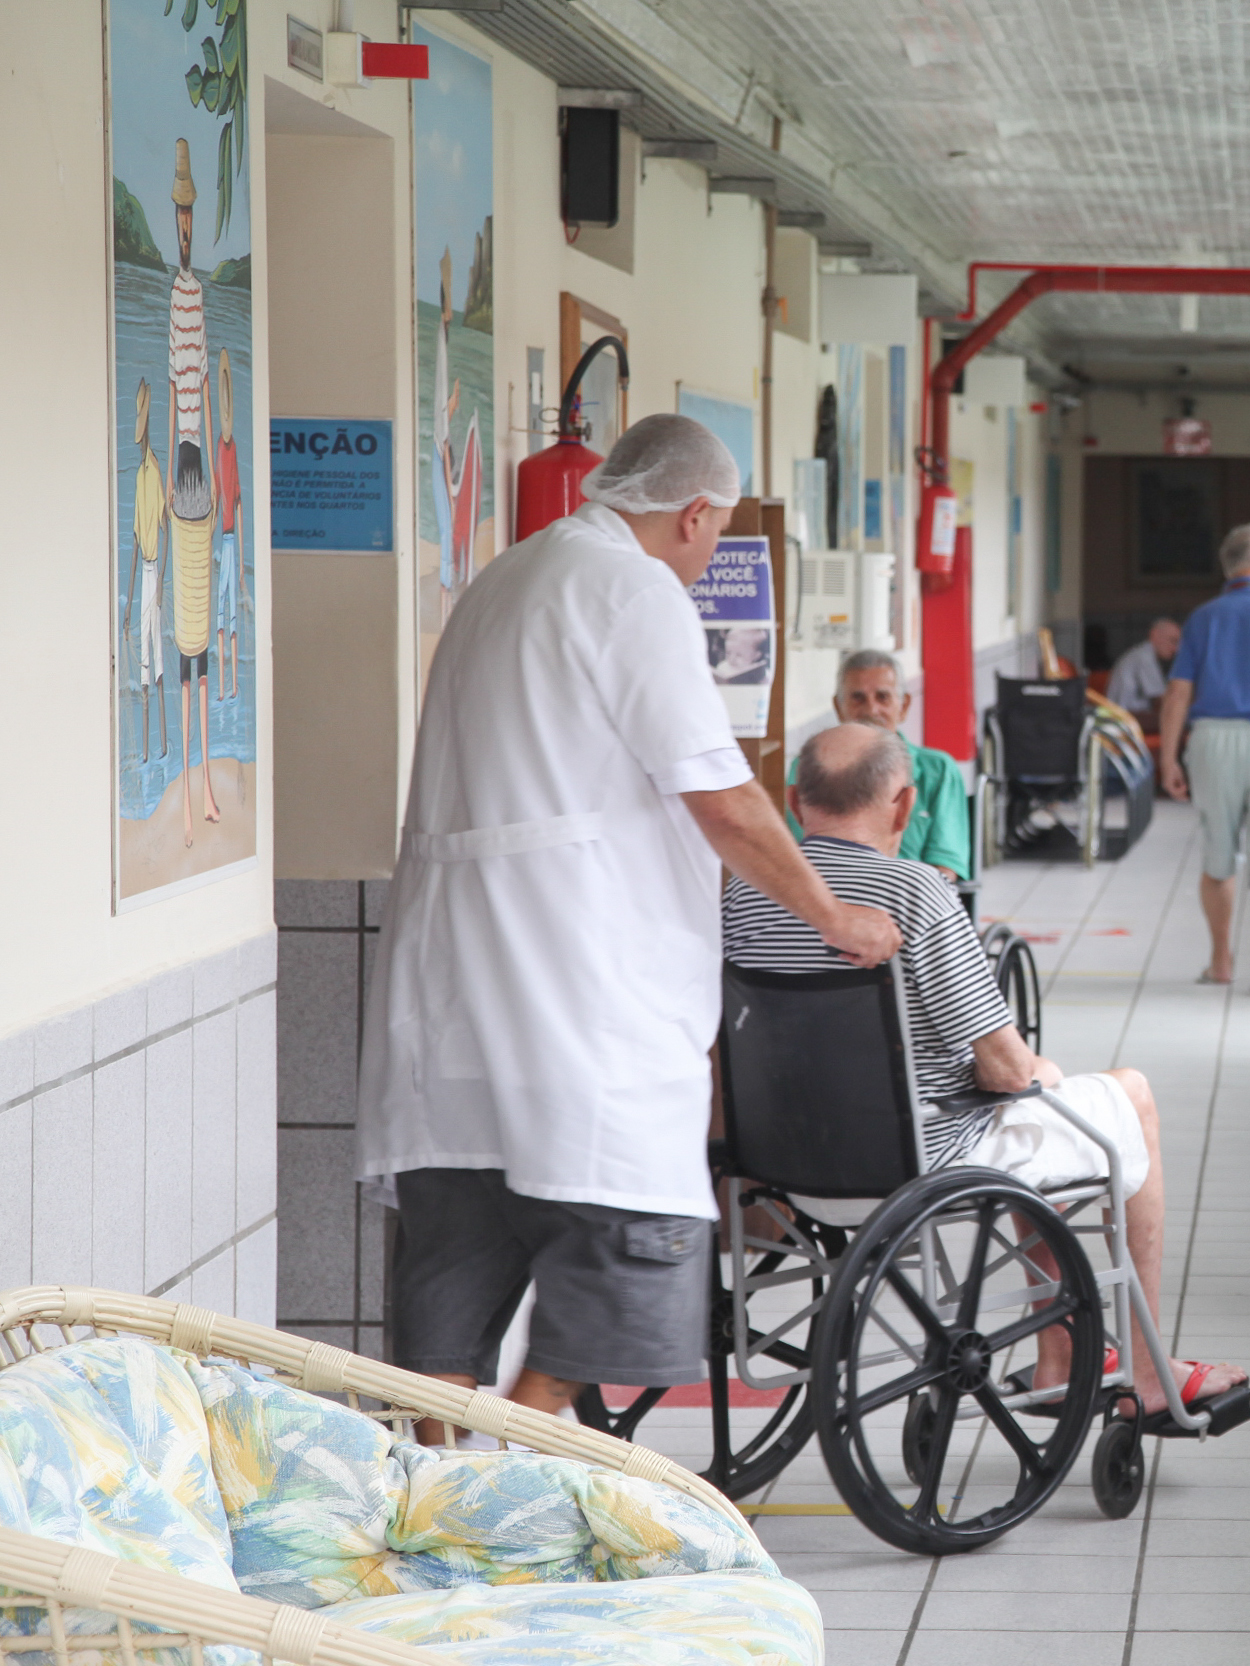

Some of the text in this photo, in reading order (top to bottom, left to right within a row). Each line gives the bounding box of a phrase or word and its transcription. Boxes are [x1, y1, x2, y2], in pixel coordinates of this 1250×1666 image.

[270, 429, 378, 460] ENÇÃO
[273, 470, 380, 480] HIGIENE PESSOAL DOS
[295, 479, 301, 488] É
[303, 480, 355, 489] PERMITIDA
[299, 491, 311, 499] DE
[315, 490, 382, 500] VOLUNTÁRIOS
[297, 501, 317, 509] NOS
[319, 502, 366, 510] QUARTOS
[283, 529, 326, 539] DIREÇÃO
[711, 565, 758, 581] VOCÊ.
